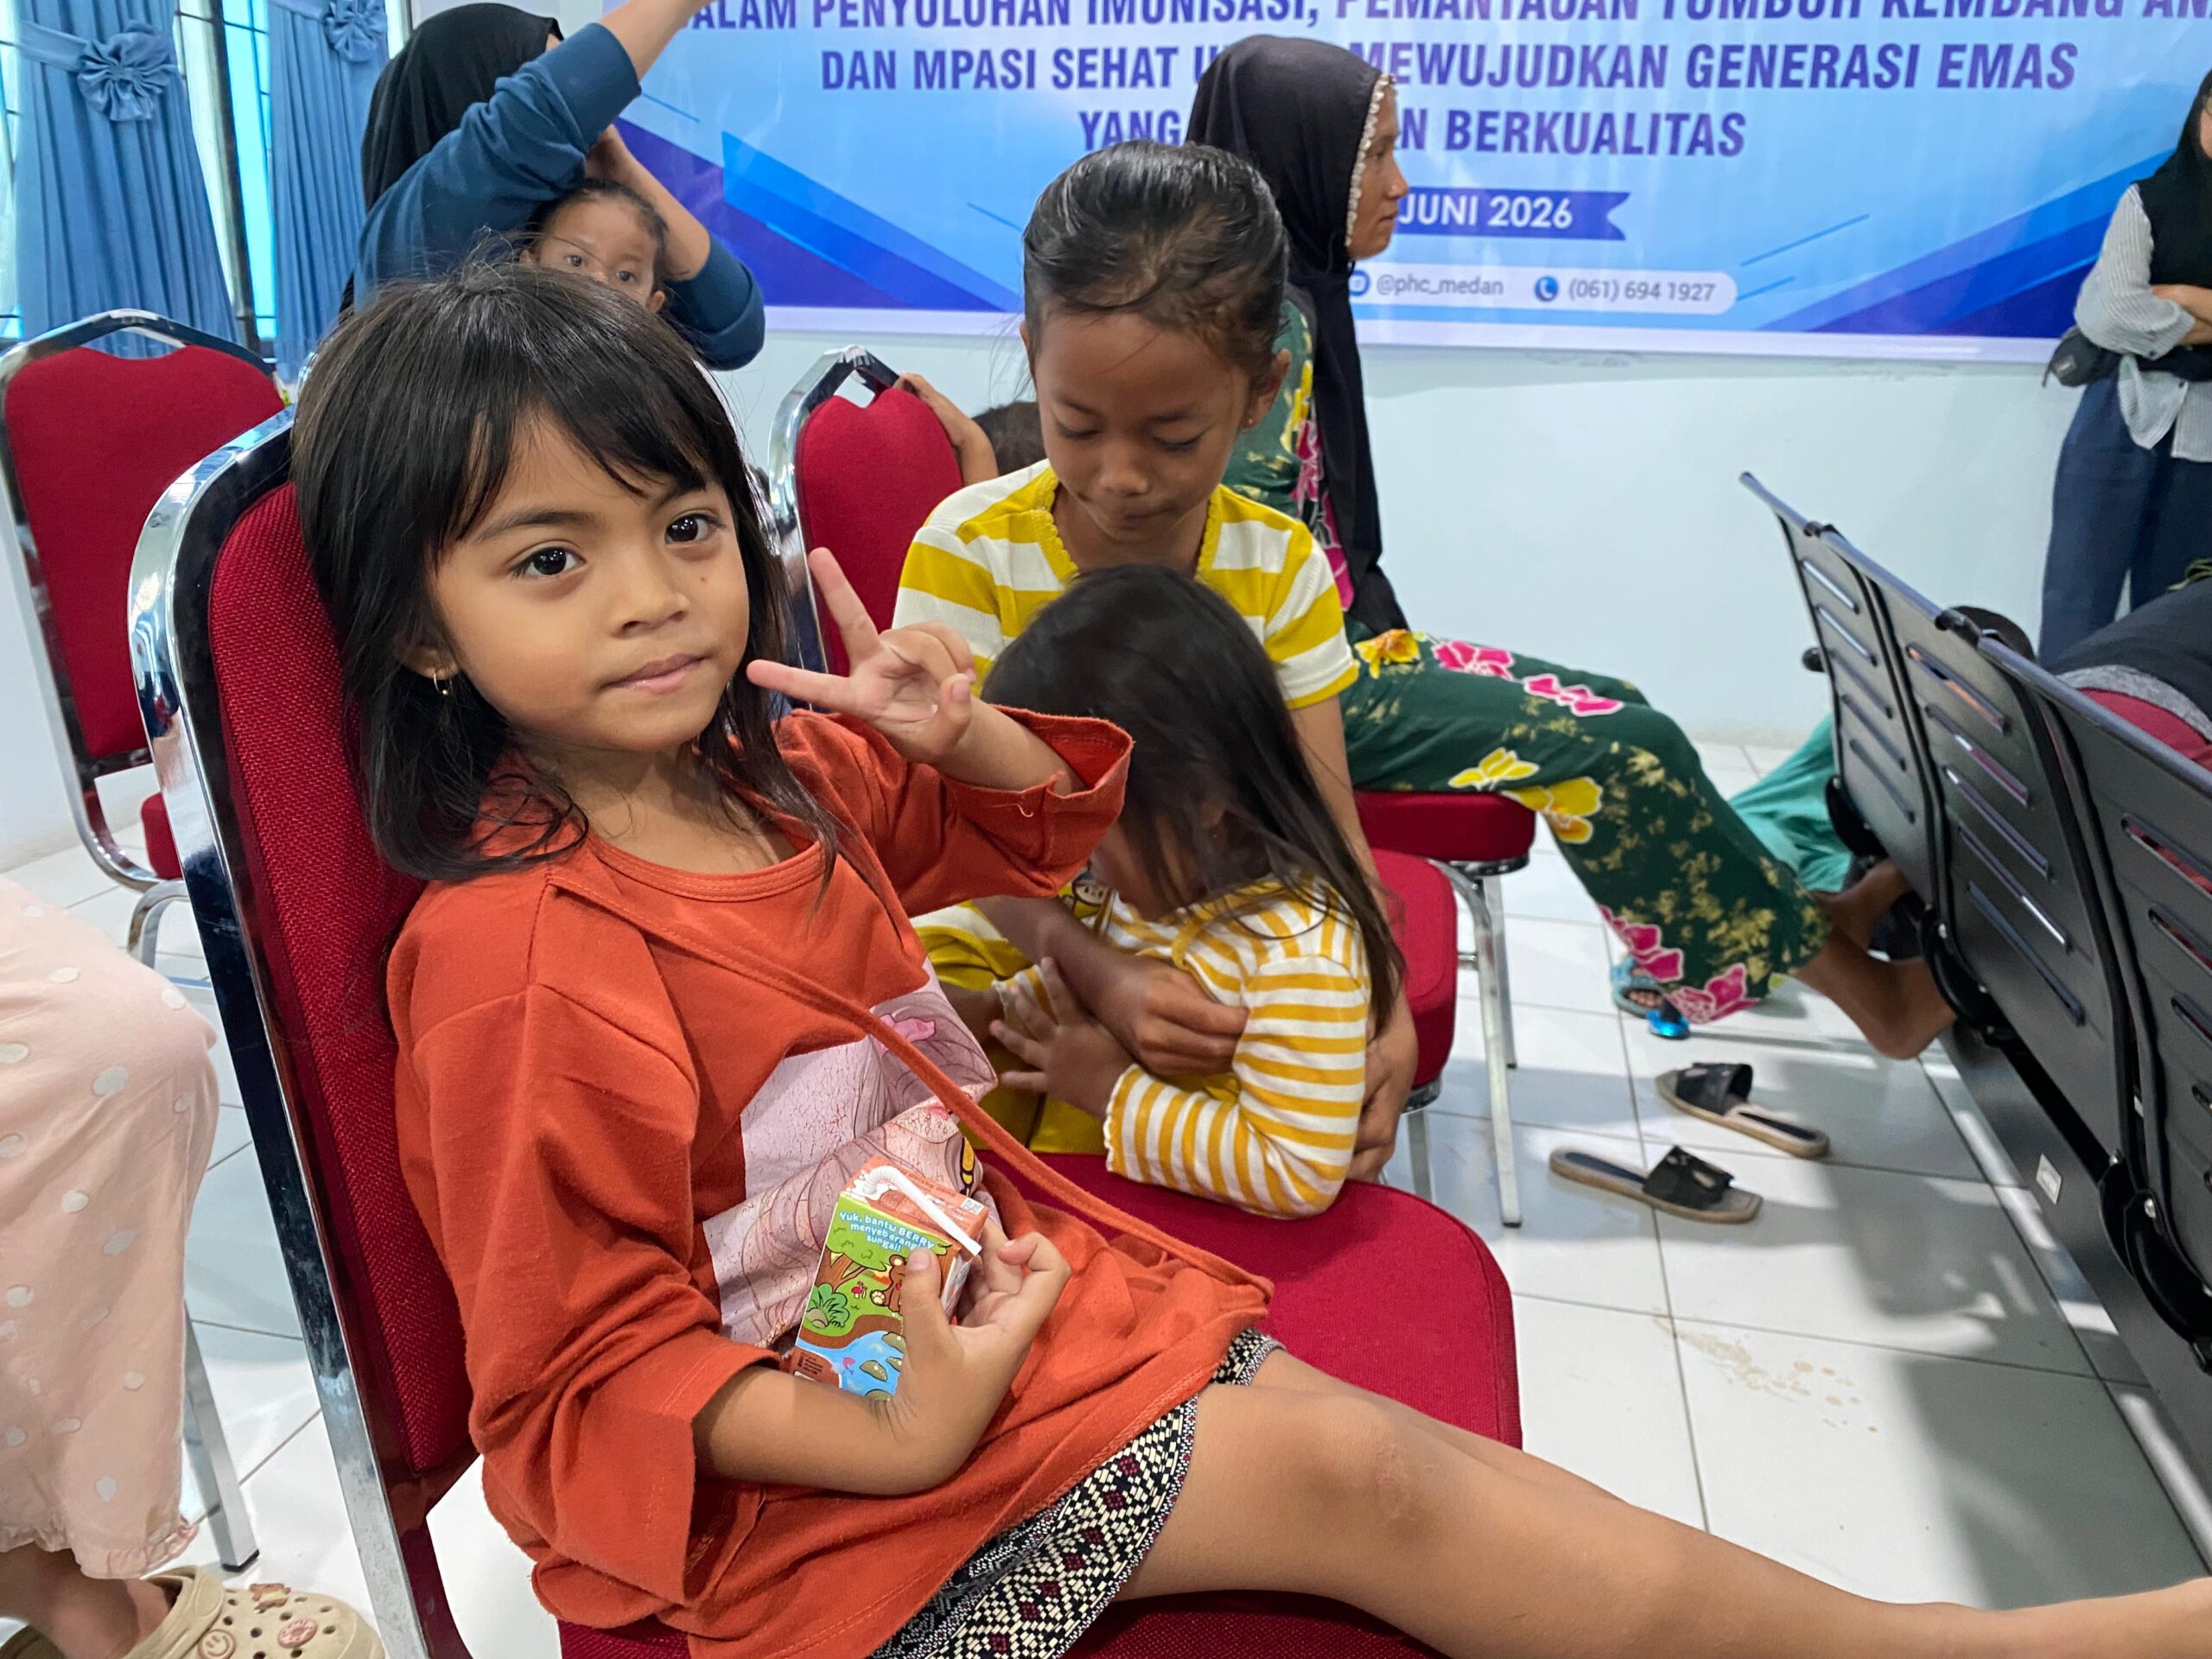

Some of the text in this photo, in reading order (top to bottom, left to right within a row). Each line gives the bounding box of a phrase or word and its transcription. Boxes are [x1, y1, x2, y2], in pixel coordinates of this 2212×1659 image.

[681, 0, 796, 29] ALAM
[822, 50, 896, 90] DAN
[913, 48, 1035, 90] MPASI
[1052, 47, 1179, 89] SEHAT
[1686, 43, 1921, 89] GENERASI
[1936, 42, 2078, 90] EMAS
[1078, 109, 1181, 151] YANG
[1446, 110, 1745, 157] BERKUALITAS
[1397, 193, 1573, 229] JUNI 2026
[1376, 273, 1504, 296] @phc_medan
[1568, 276, 1717, 302] (061) 694 1927
[839, 1211, 935, 1249] Yuk, bantu BERRY
